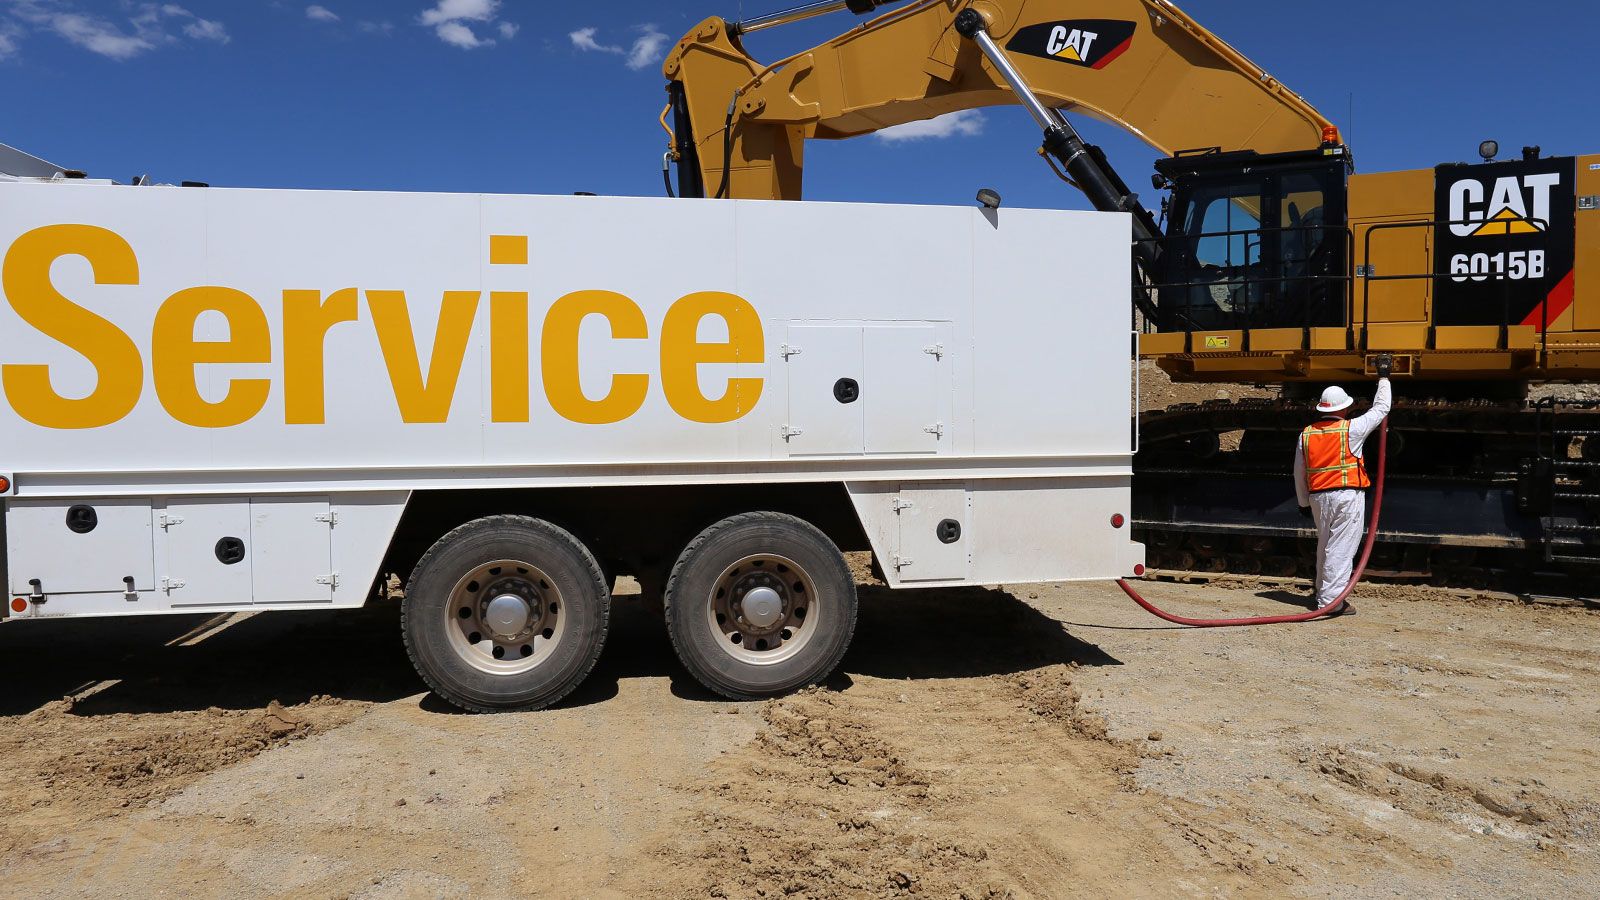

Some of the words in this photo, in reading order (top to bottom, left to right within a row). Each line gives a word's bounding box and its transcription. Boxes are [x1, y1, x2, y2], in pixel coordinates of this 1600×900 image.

[1046, 25, 1098, 62] CAT
[1449, 172, 1560, 237] CAT
[1450, 250, 1545, 282] 6015B
[1, 223, 765, 429] Service
